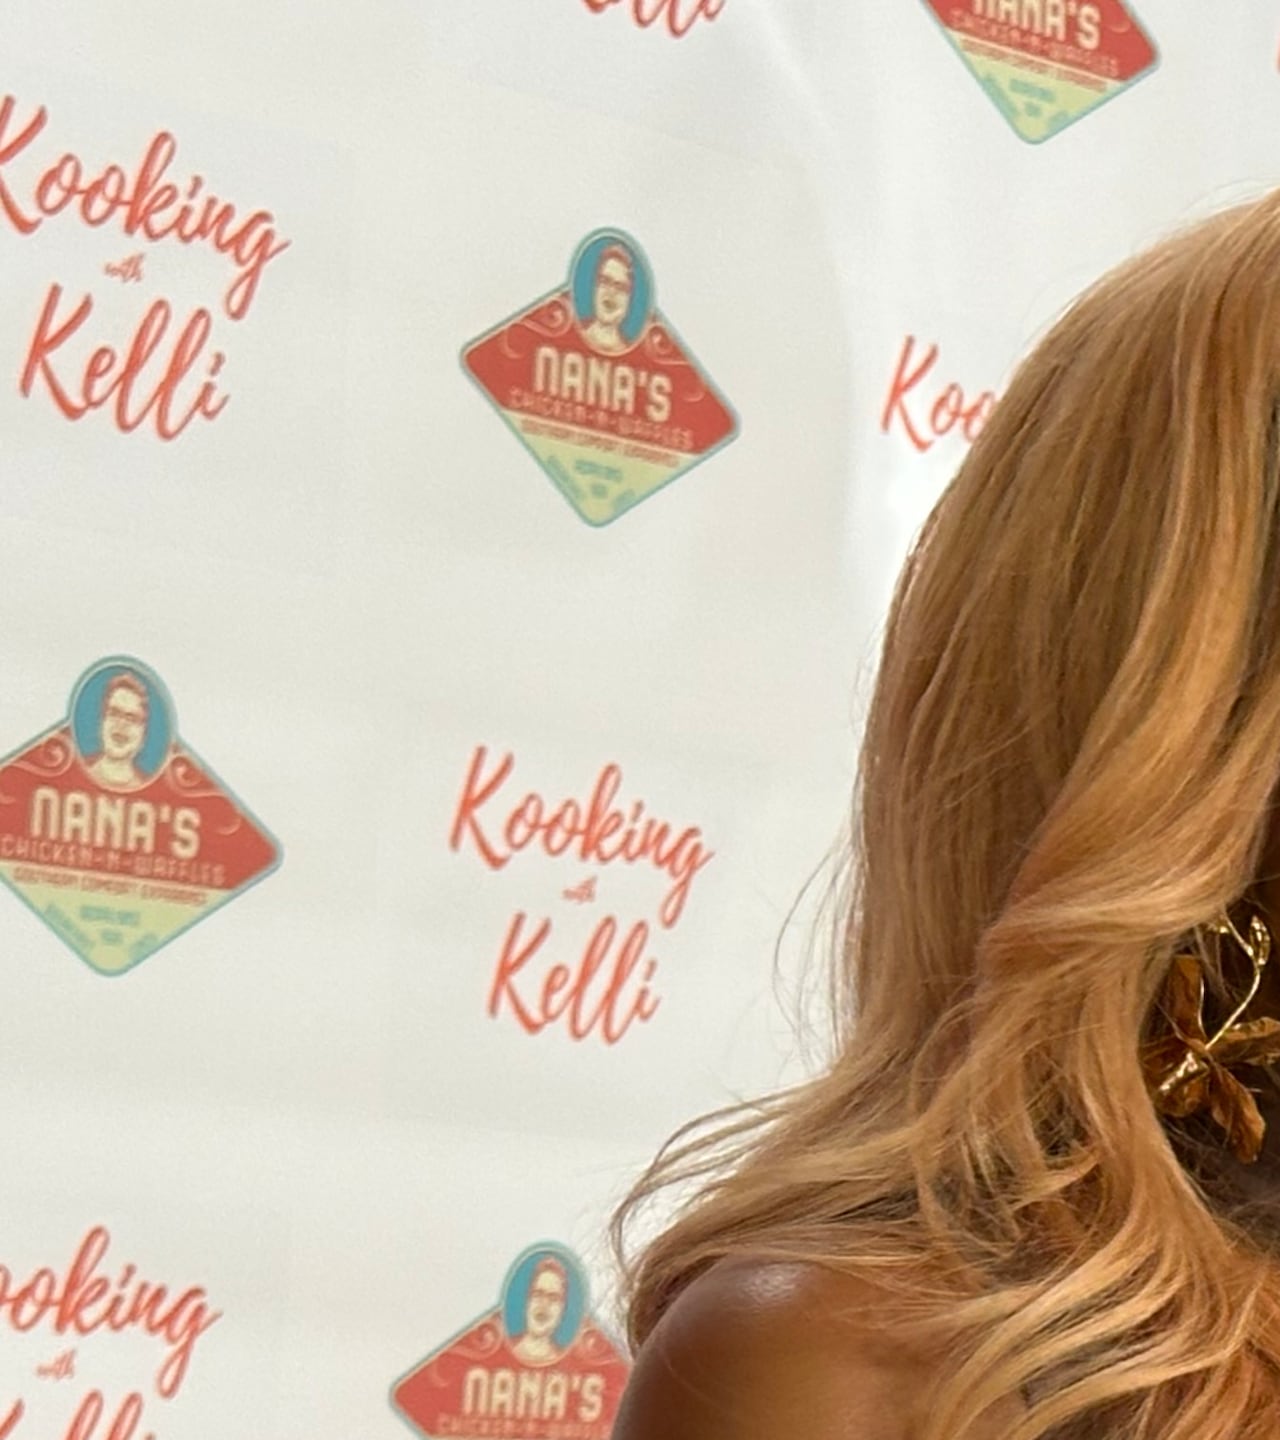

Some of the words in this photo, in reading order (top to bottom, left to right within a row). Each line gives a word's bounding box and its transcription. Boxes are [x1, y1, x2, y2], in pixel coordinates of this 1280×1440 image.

[0, 95, 293, 321] Kooking
[19, 283, 231, 443] Kelli
[533, 346, 674, 423] NANA'S
[30, 787, 202, 860] NANA'S
[450, 745, 716, 930] Kooking
[487, 911, 663, 1046] Kelli
[0, 1224, 224, 1400] oking
[462, 1366, 606, 1423] NANA'S
